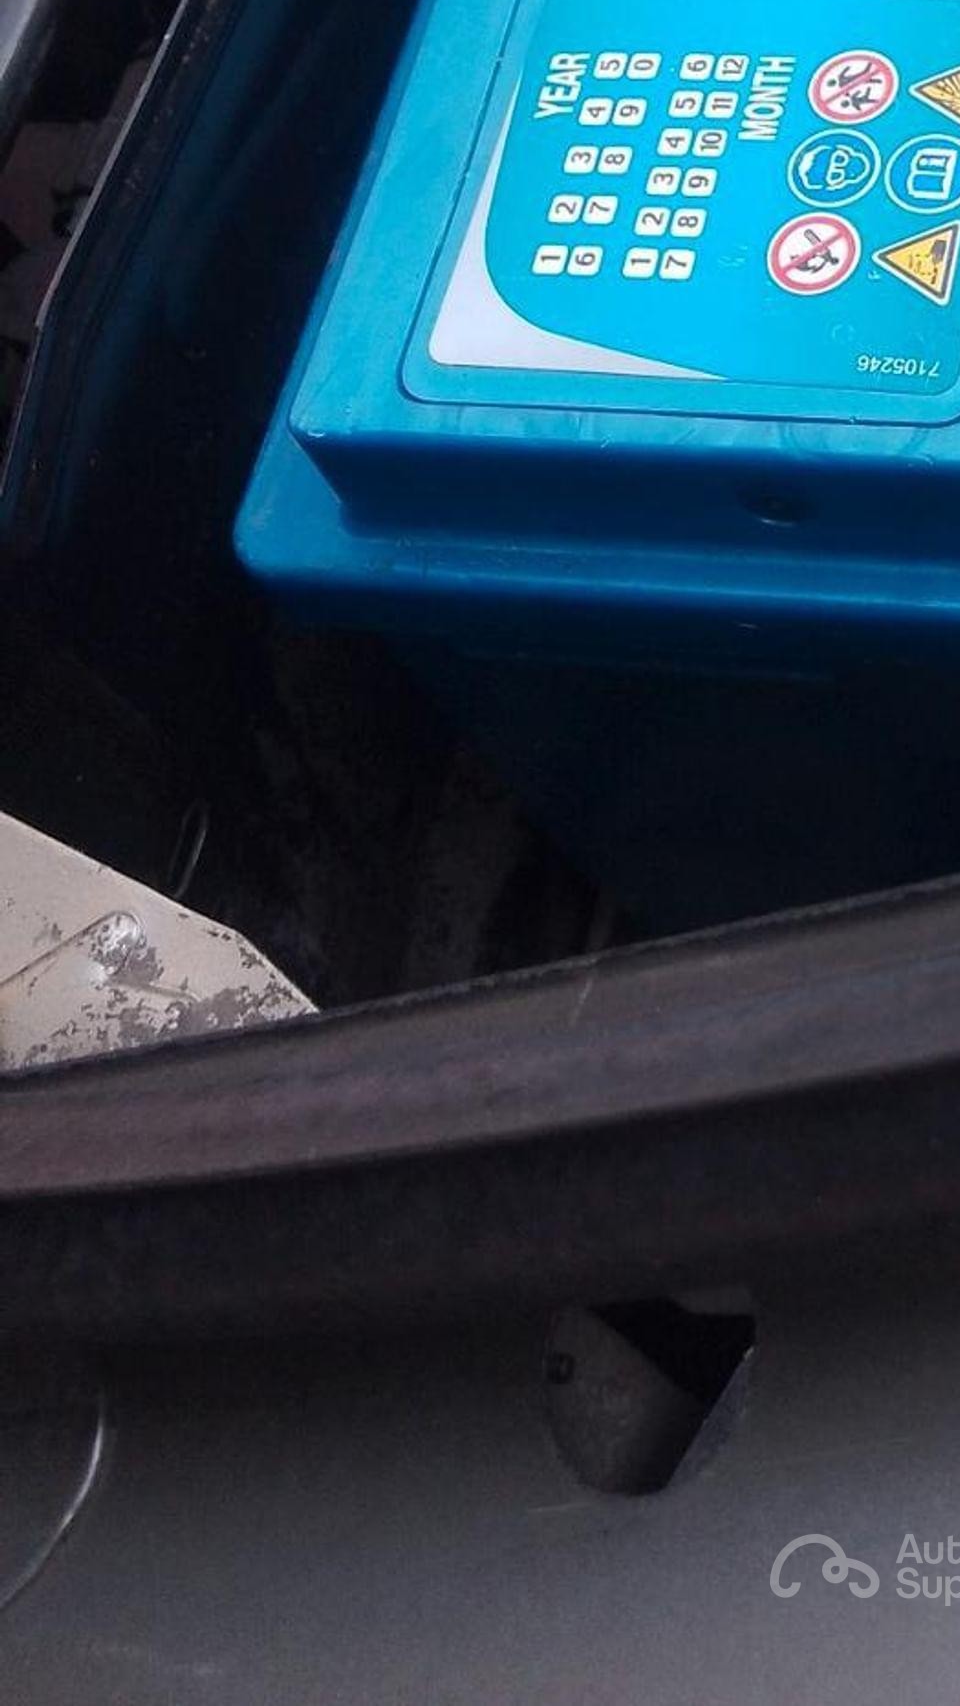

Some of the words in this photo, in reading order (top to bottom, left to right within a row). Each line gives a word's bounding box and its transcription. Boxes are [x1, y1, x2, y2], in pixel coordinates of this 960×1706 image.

[722, 58, 745, 76] 12
[534, 52, 591, 119] YEAR
[711, 97, 733, 111] 11
[738, 56, 796, 141] MONTH
[700, 131, 723, 151] 10
[856, 354, 940, 377] 7105246
